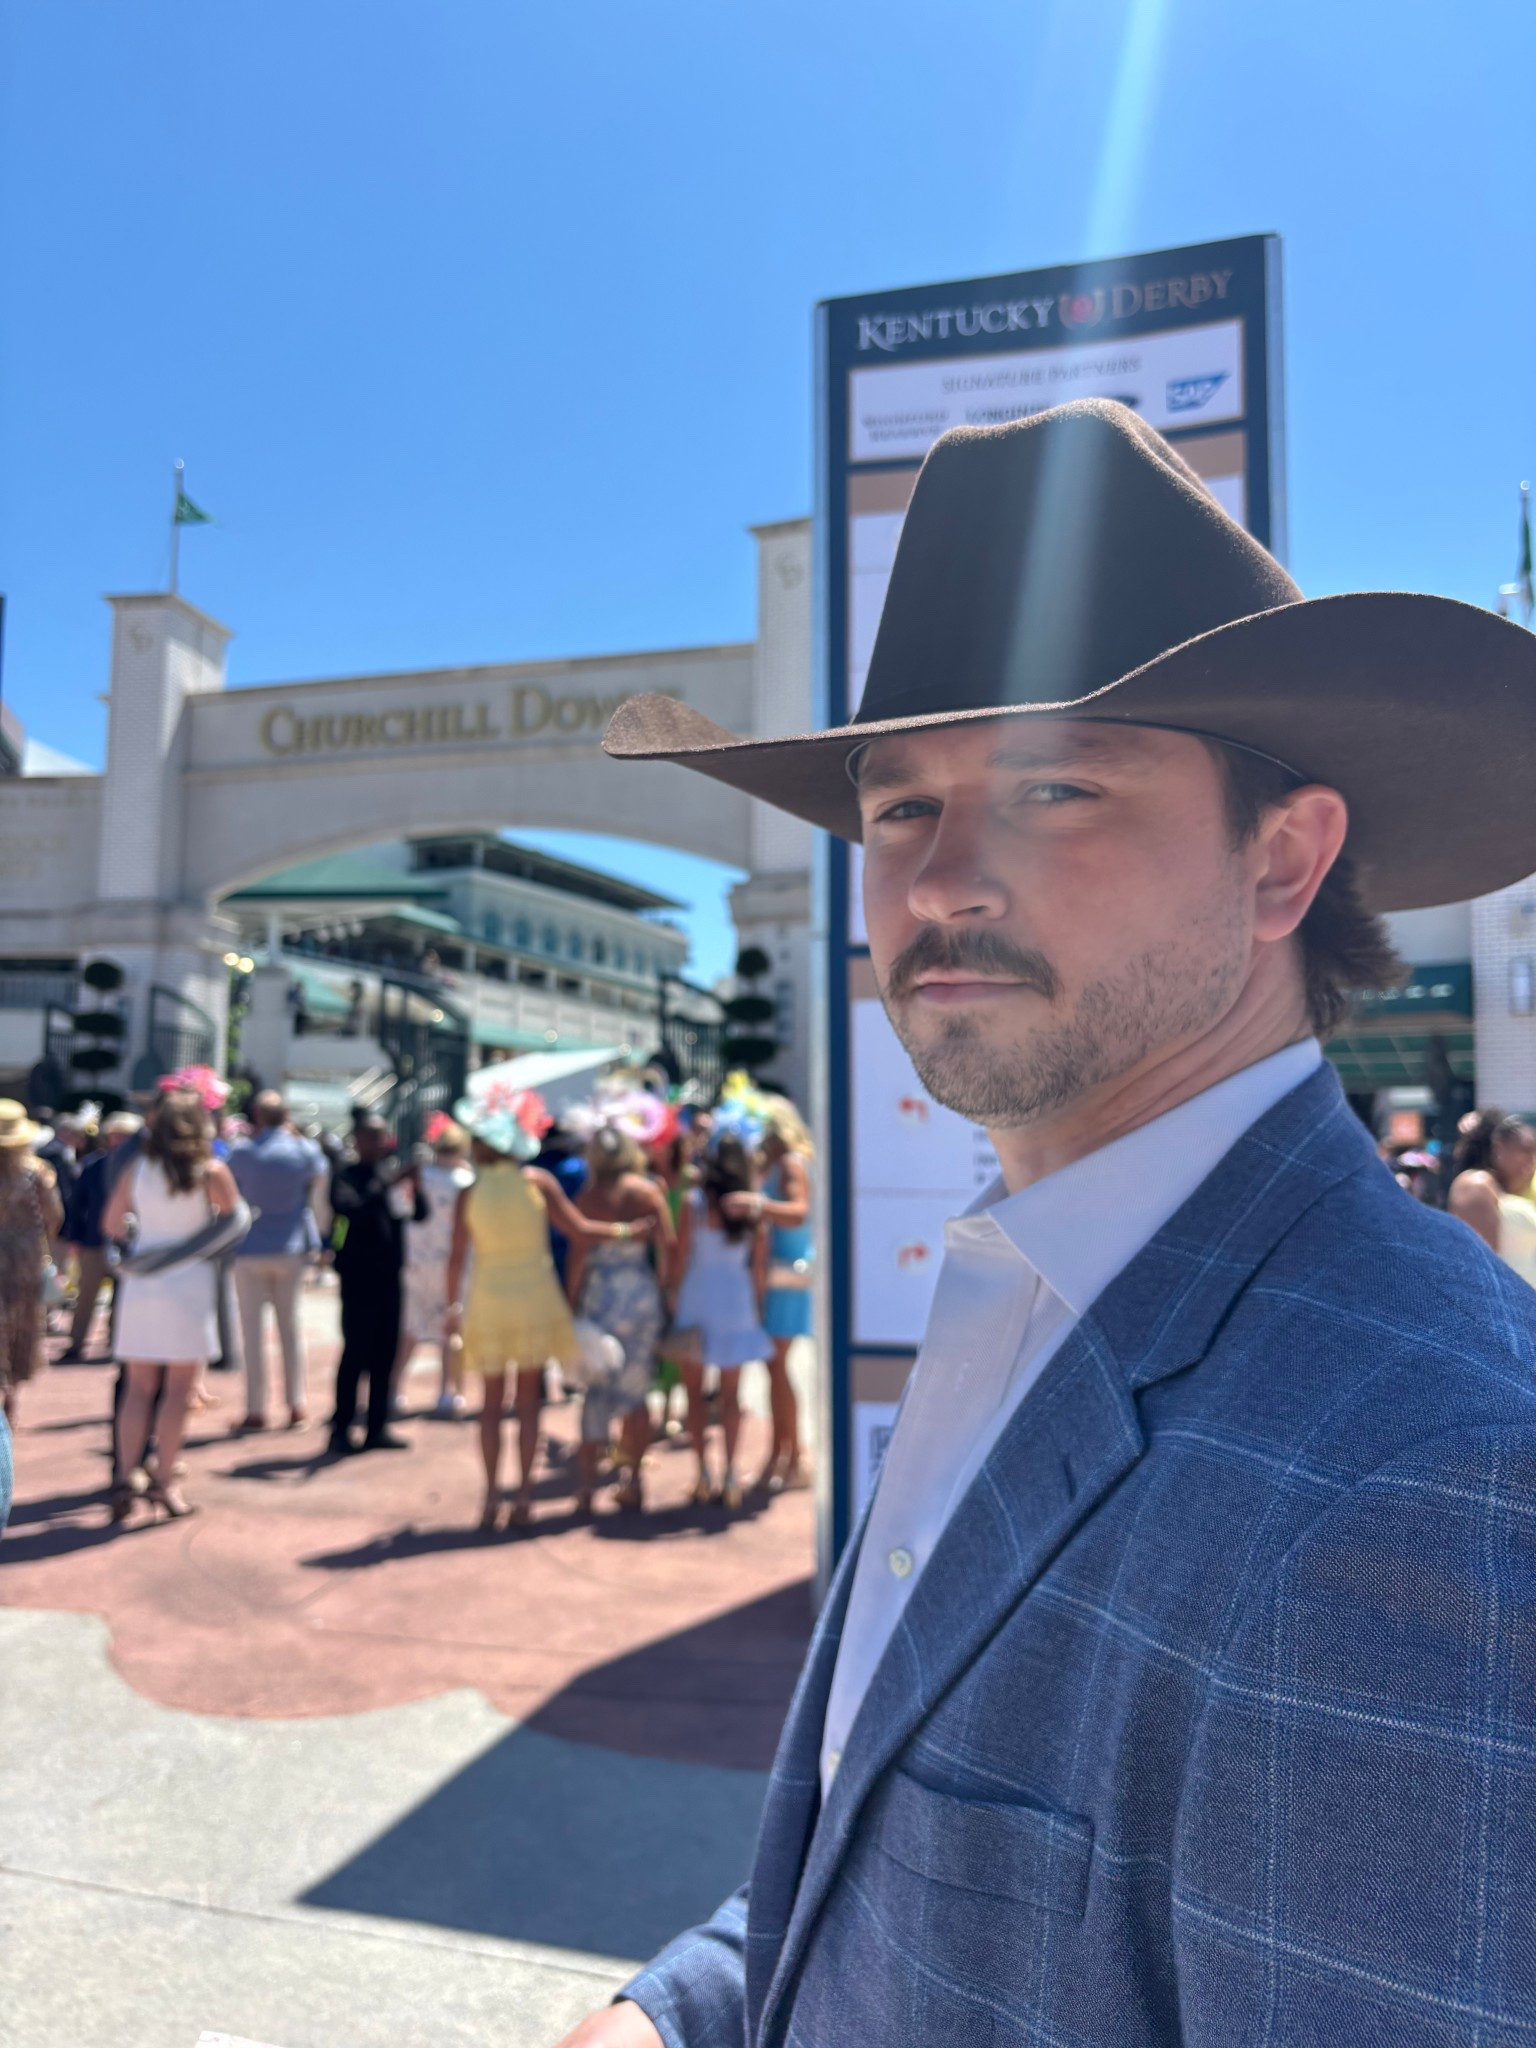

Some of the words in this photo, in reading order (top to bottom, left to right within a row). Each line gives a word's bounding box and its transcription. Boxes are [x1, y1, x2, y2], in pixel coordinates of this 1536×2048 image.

[857, 299, 1054, 352] KENTUCKY
[1112, 271, 1232, 320] DERBY
[259, 707, 501, 756] CHURCHILL
[511, 685, 684, 737] DOW
